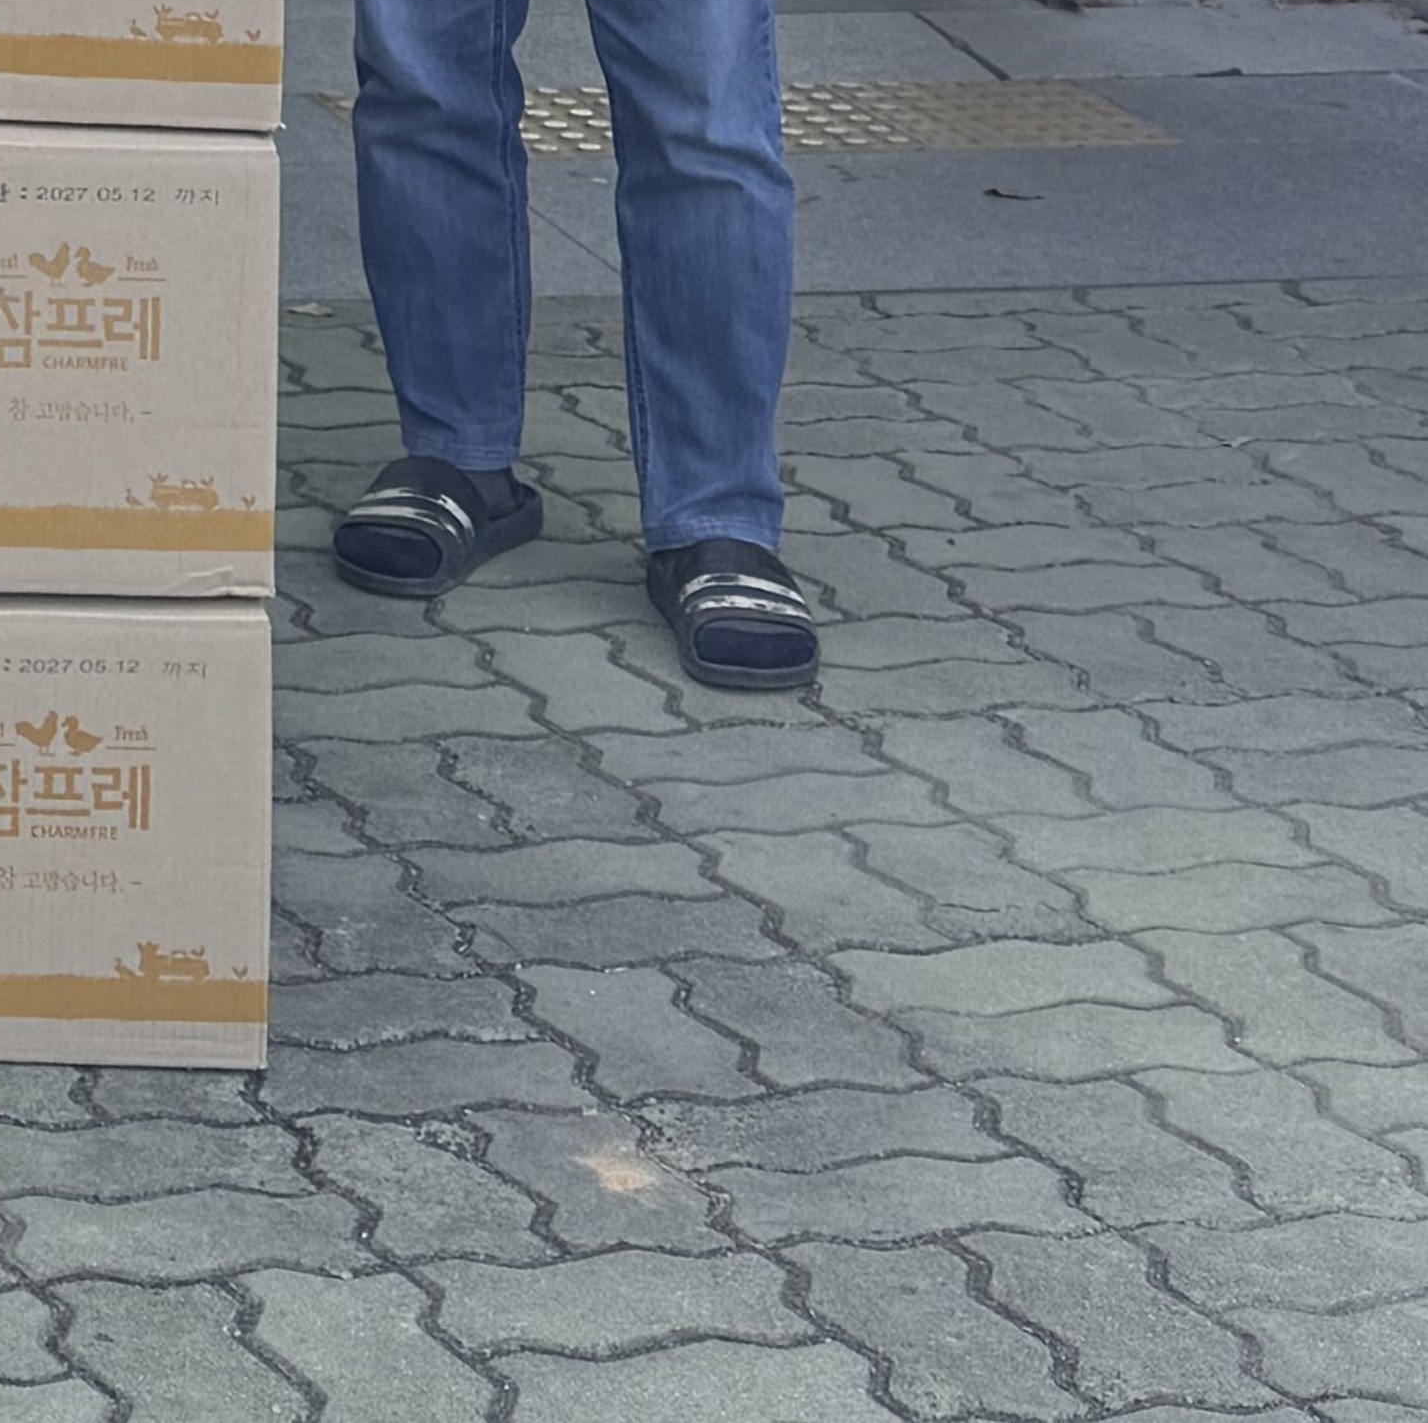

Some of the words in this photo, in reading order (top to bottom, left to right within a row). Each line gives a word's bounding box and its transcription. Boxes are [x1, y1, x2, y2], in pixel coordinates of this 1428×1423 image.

[175, 187, 220, 205] 까지
[162, 661, 206, 679] 까지
[115, 726, 148, 741] Fresh
[31, 825, 118, 840] CHARMFRE
